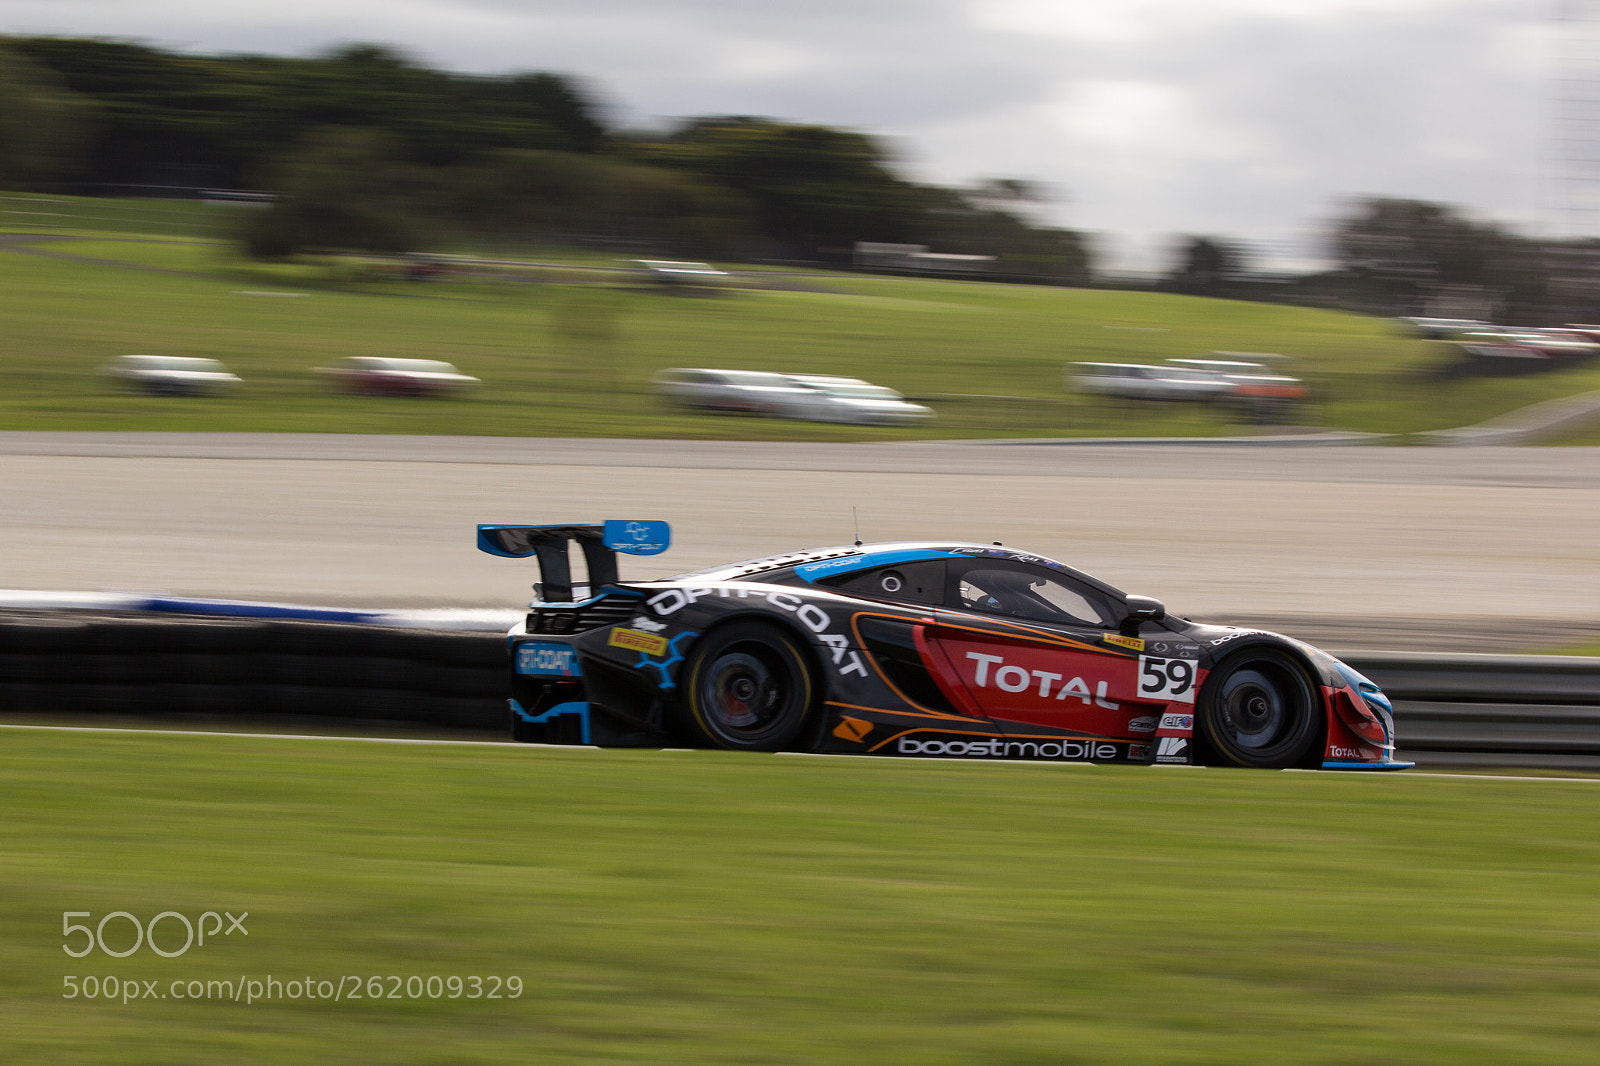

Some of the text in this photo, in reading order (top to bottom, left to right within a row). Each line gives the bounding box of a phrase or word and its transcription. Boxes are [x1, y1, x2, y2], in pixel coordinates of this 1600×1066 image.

[614, 631, 662, 652] PIRELLI
[646, 587, 868, 678] OPTI-COAT
[1107, 634, 1142, 649] PIRELLI
[965, 651, 1120, 711] TOTAL
[1141, 657, 1192, 695] 59
[898, 736, 1117, 759] boostmobile
[1329, 745, 1360, 758] TOTAL
